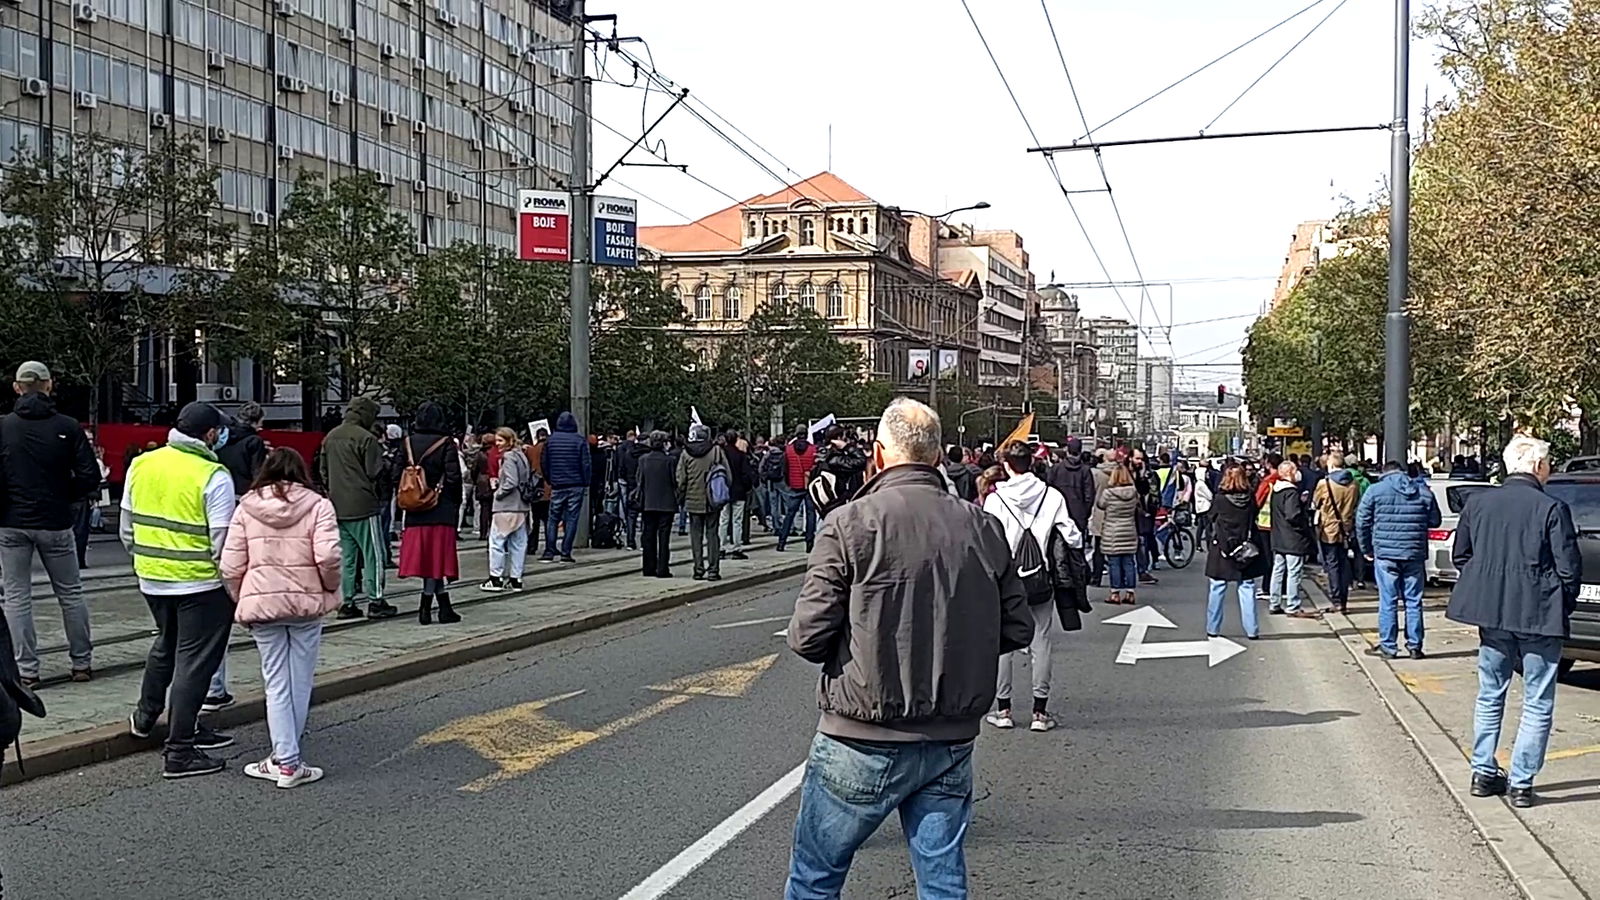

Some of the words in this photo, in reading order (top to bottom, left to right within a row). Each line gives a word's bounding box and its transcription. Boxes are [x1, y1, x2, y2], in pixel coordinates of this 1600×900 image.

[533, 197, 566, 208] ROMA
[606, 203, 634, 216] ROMA
[532, 216, 556, 228] BOJE
[606, 222, 625, 234] BOJE
[606, 234, 635, 247] FASADE
[605, 246, 634, 259] TAPETE
